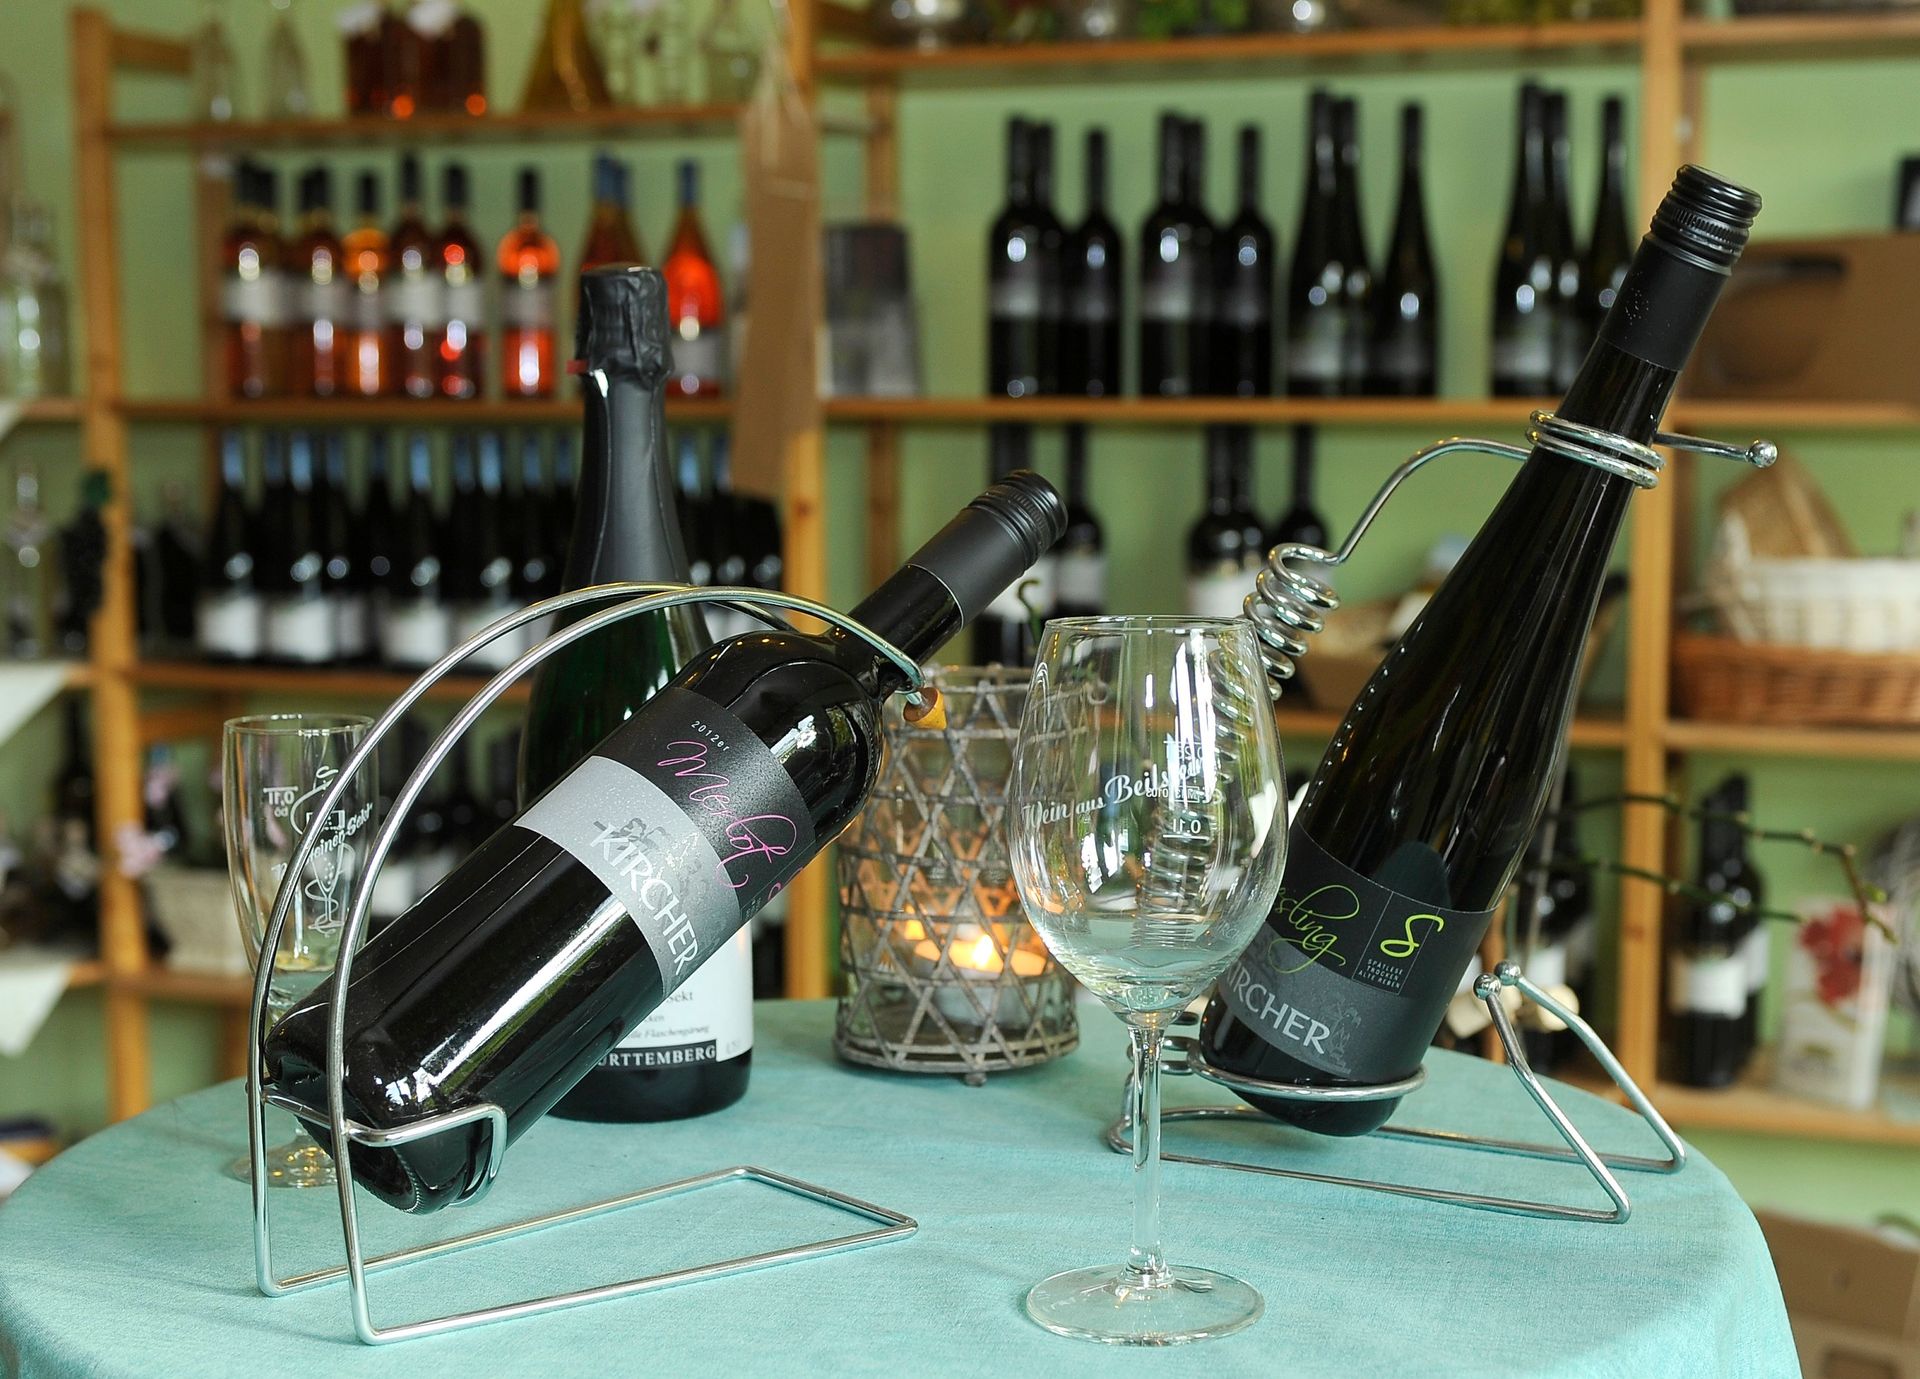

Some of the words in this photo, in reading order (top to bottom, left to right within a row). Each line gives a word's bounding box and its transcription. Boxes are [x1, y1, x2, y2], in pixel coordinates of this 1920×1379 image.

[691, 720, 730, 752] 2012er
[656, 739, 797, 889] Merlot
[1021, 800, 1072, 833] Wein
[1075, 796, 1107, 815] aus
[590, 819, 700, 976] KIRCHER
[1358, 970, 1375, 982] ALTE
[1366, 965, 1399, 981] TROCKEN
